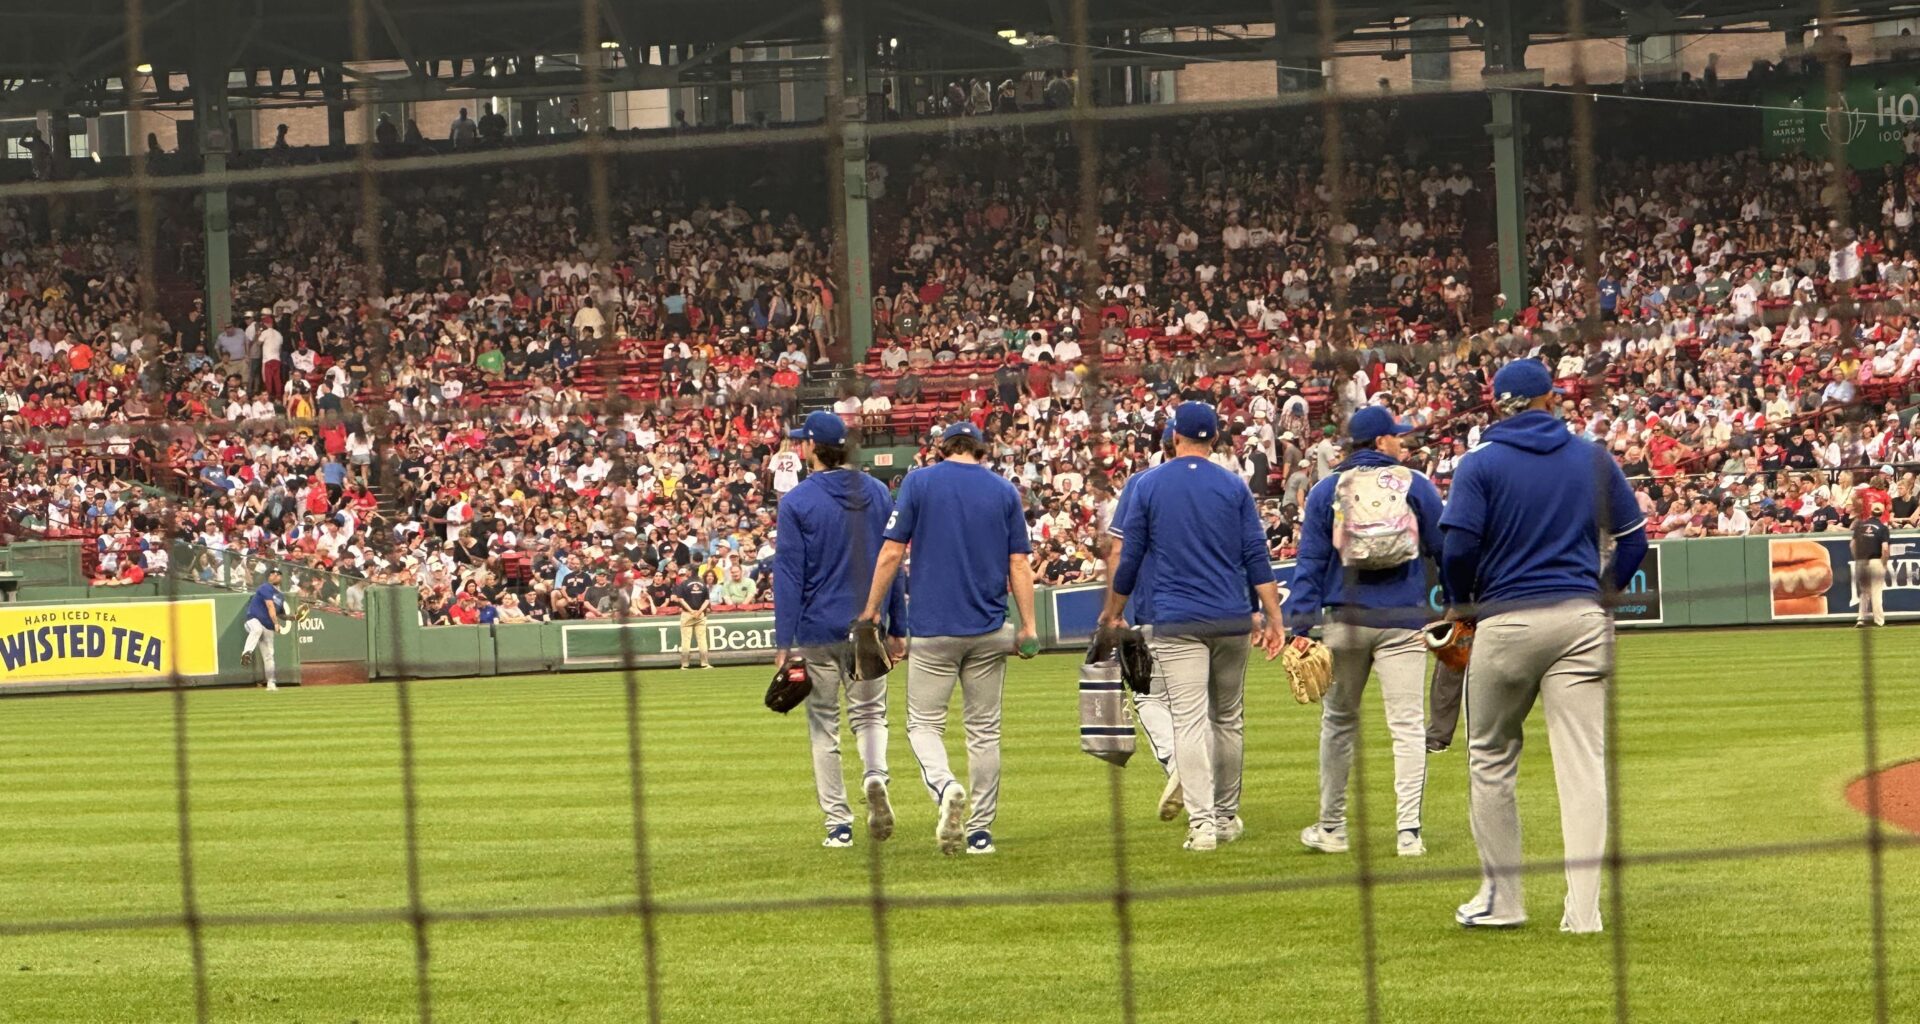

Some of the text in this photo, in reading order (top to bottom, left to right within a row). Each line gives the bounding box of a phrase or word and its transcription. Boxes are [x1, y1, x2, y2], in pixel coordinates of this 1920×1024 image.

[777, 461, 794, 473] 42
[24, 611, 117, 625] HARD ICED TEA
[112, 626, 162, 672] TEA
